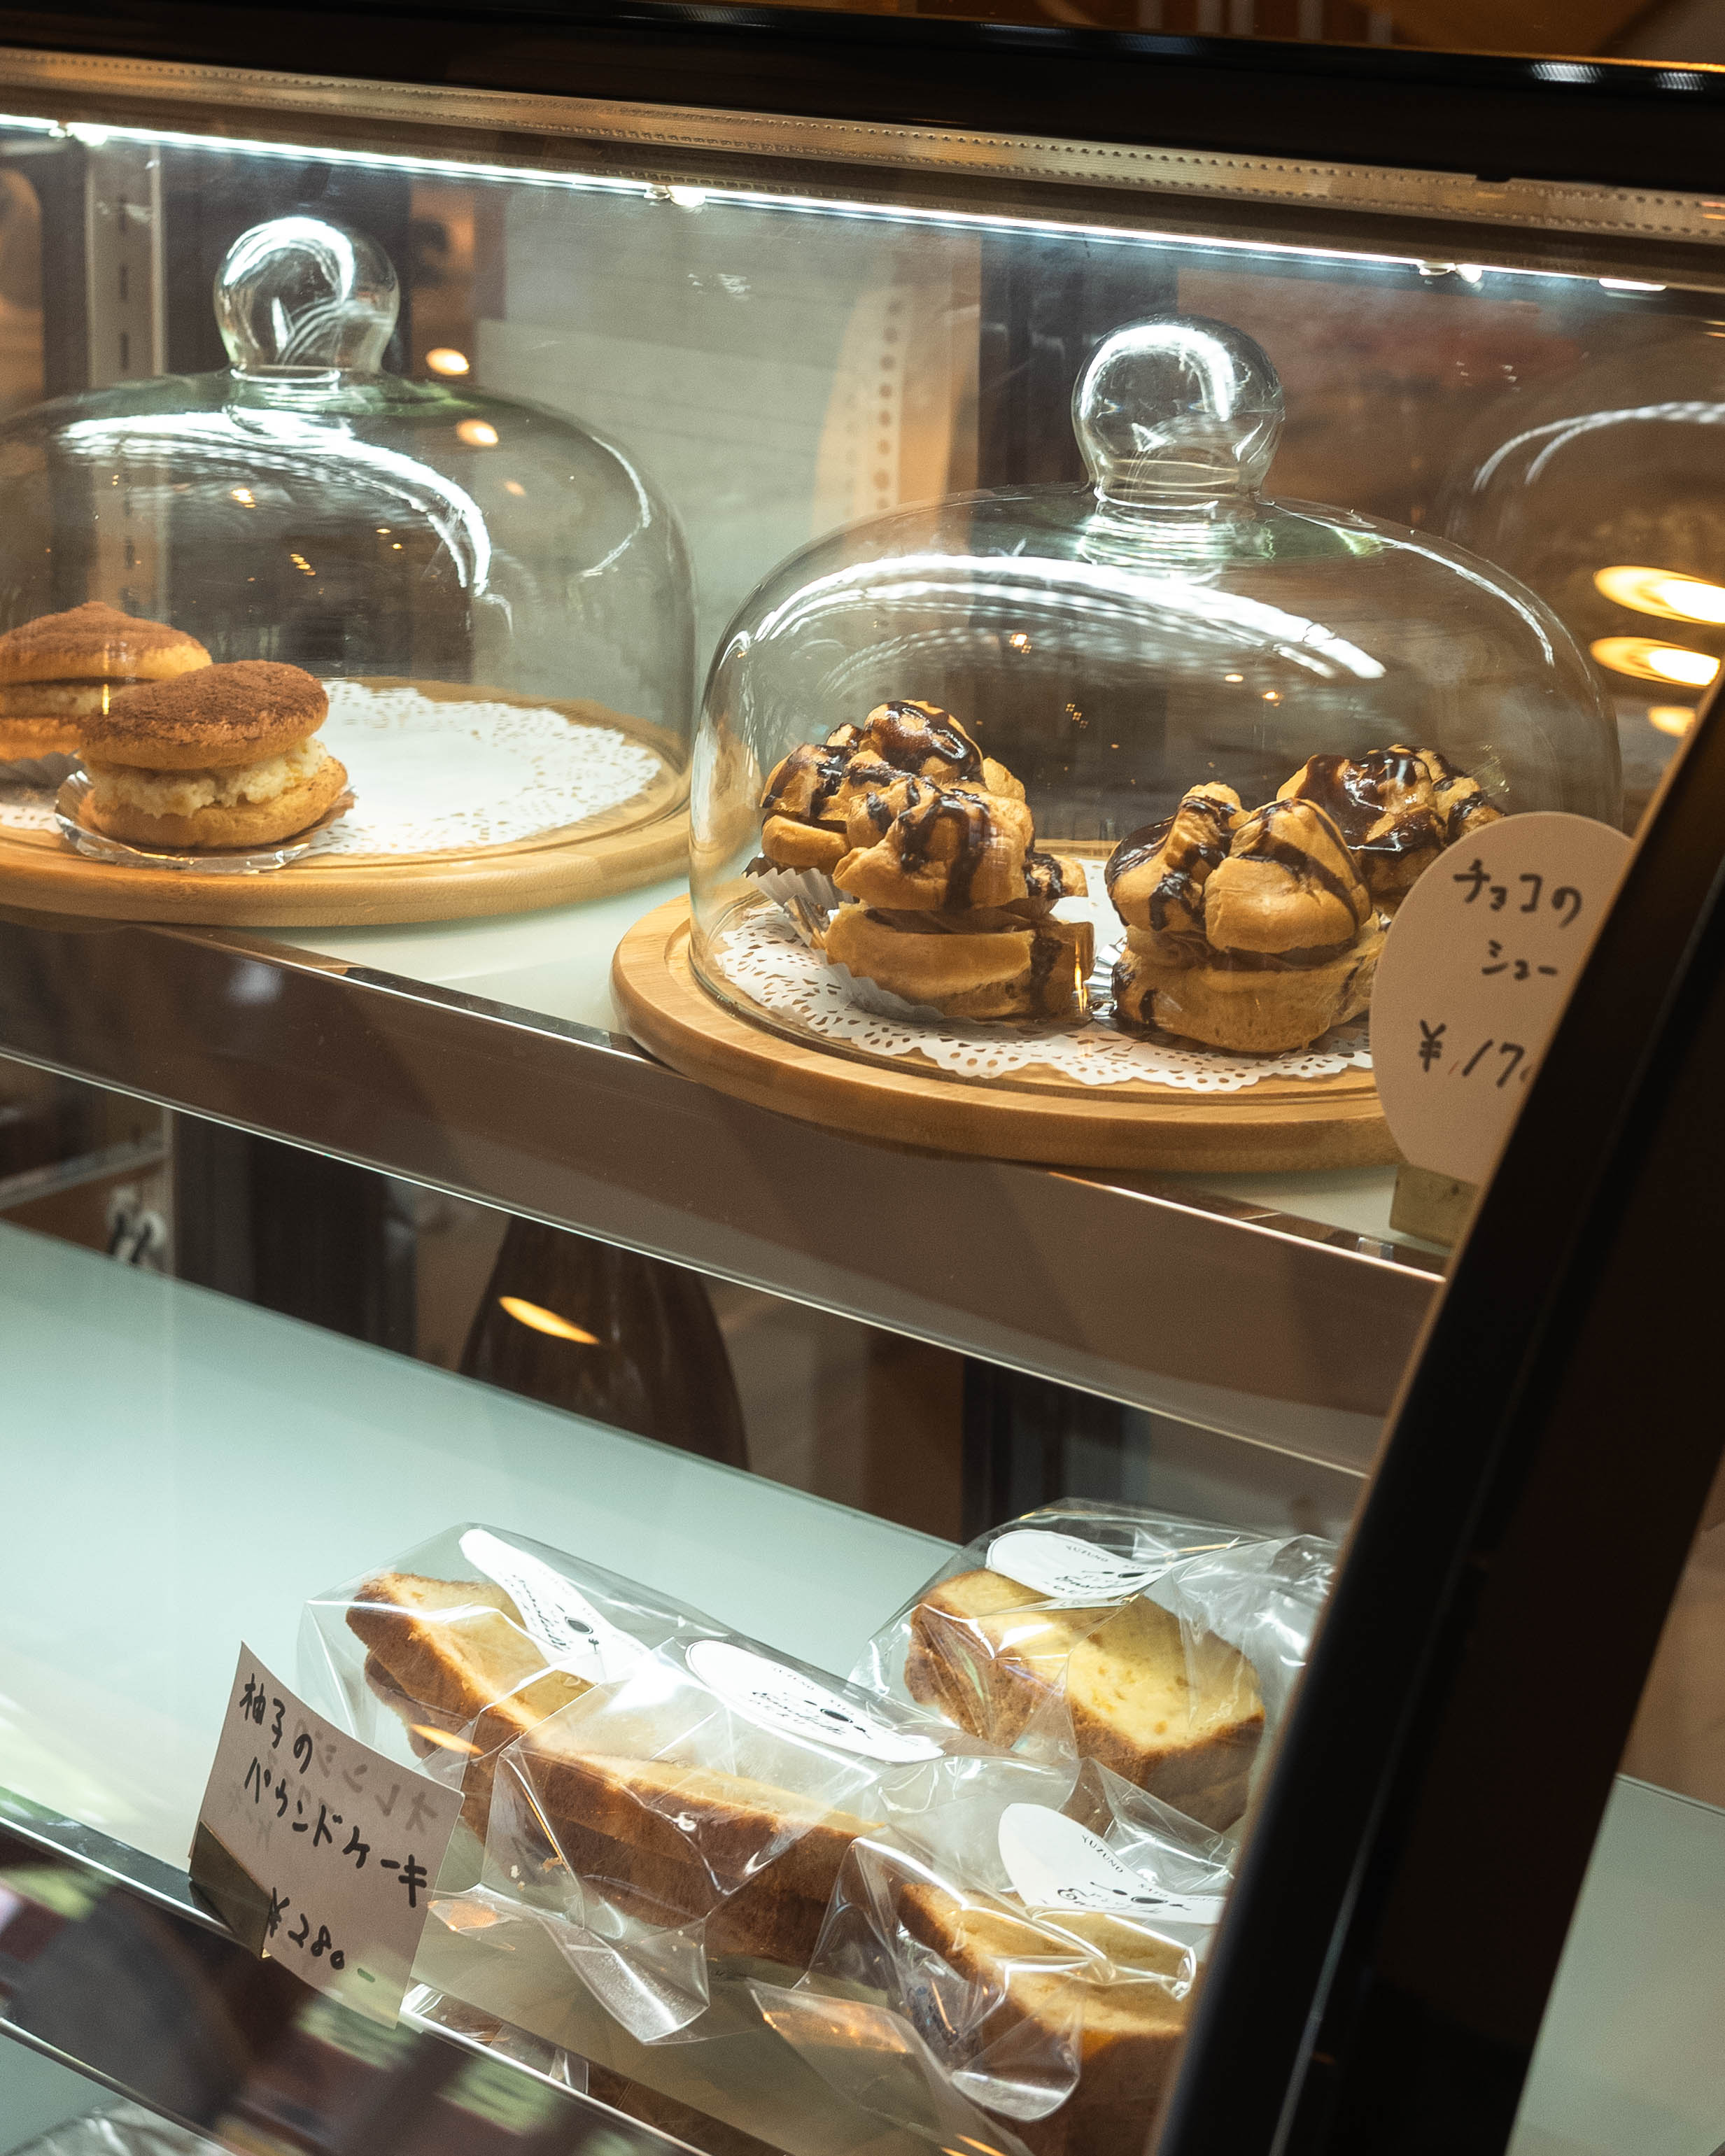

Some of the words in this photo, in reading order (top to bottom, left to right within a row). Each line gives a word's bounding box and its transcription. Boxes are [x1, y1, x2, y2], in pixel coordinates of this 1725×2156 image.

[1453, 859, 1582, 929] チョコの
[1081, 1835, 1123, 1873] YUZUNO
